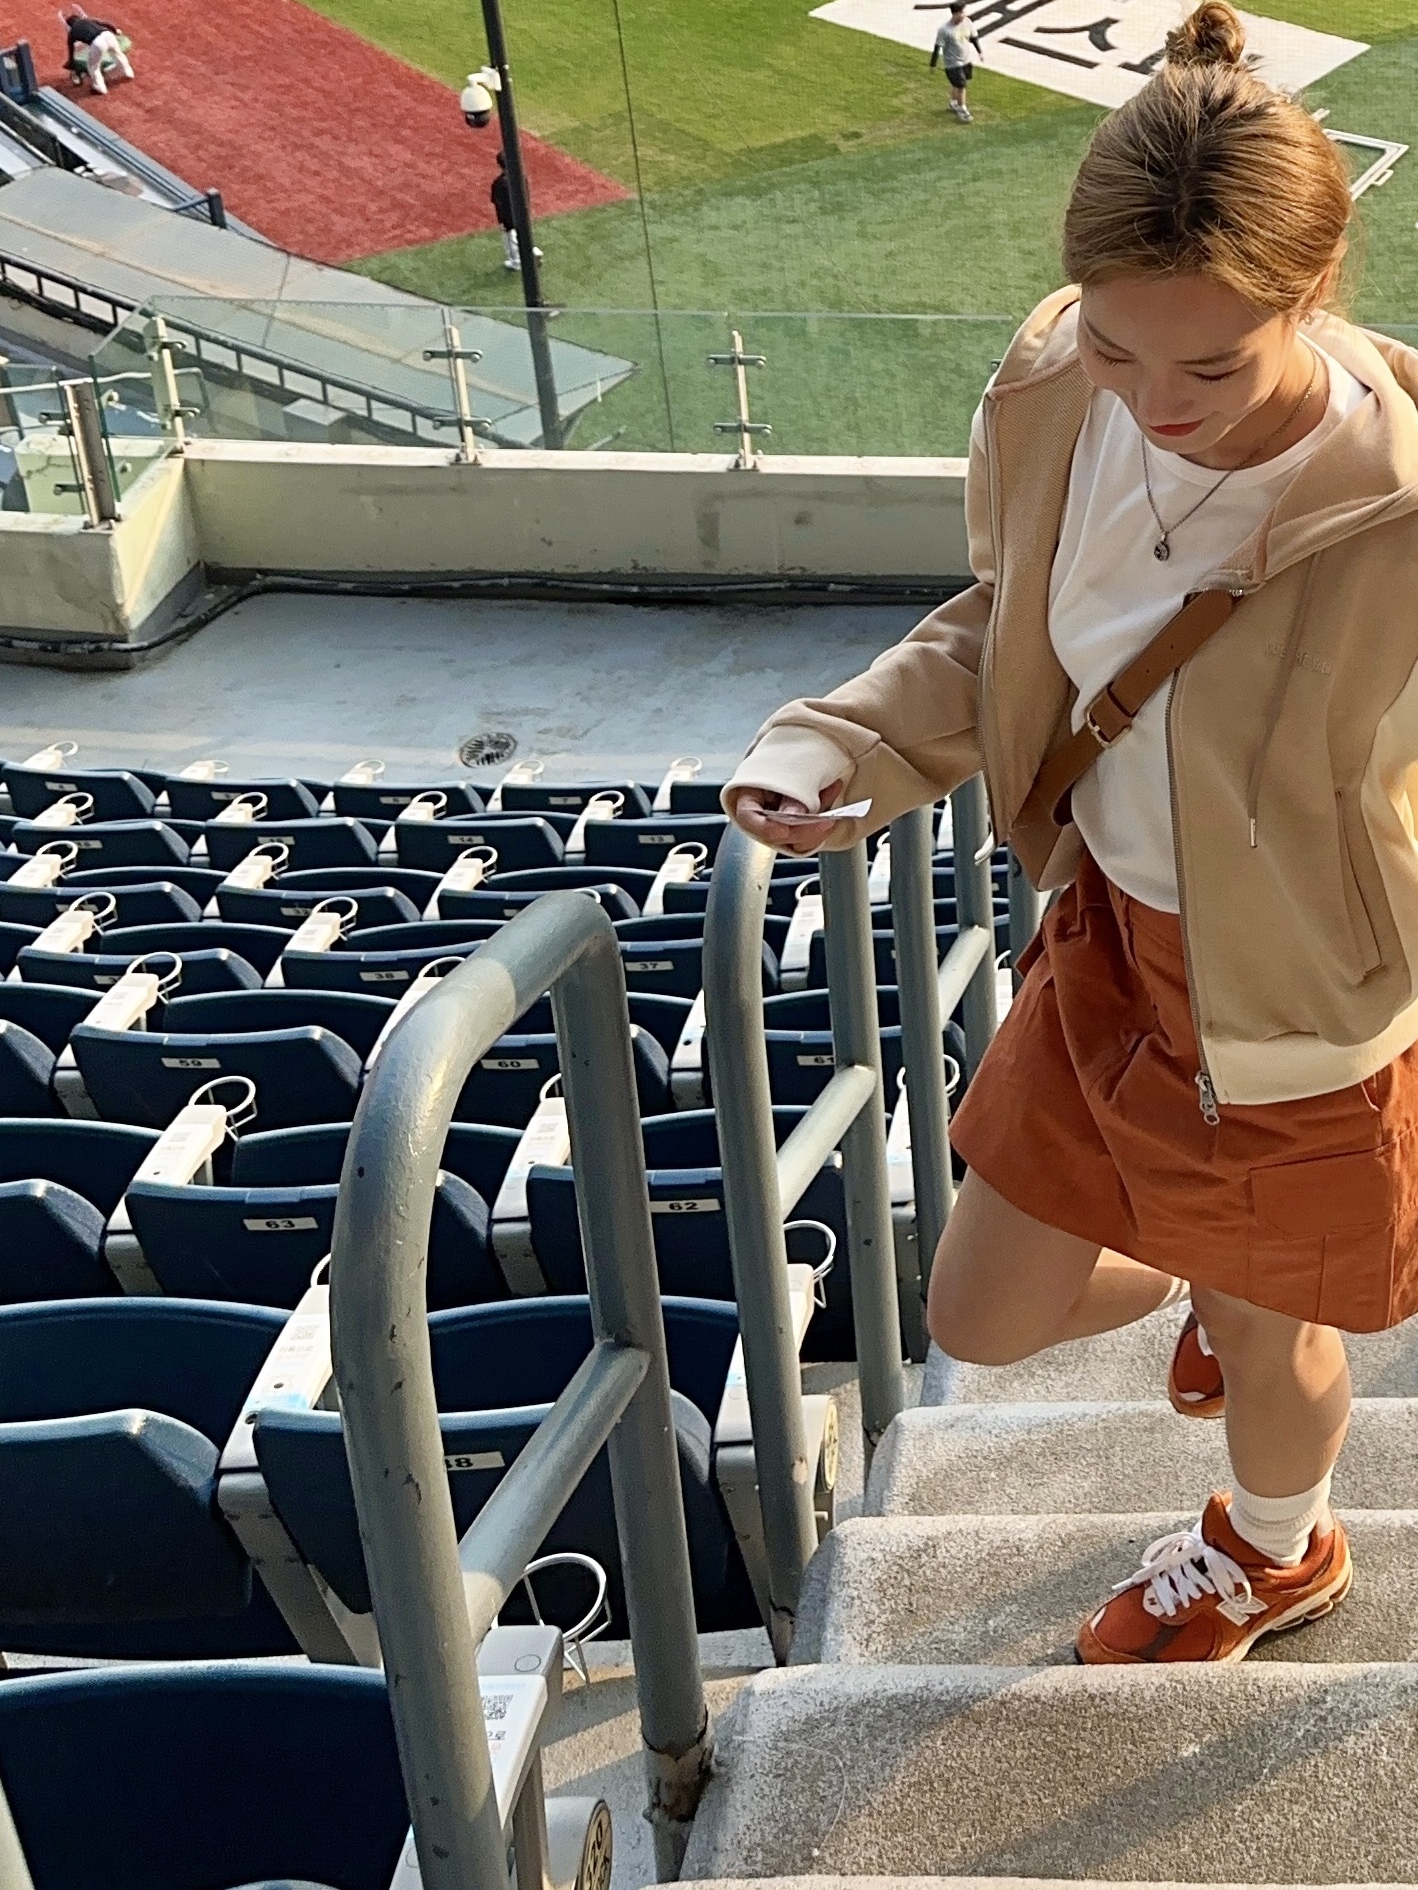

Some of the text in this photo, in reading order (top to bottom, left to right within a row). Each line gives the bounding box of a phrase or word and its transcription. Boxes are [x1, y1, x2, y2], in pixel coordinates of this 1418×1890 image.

[639, 962, 658, 970] 37
[497, 1059, 521, 1068] 60
[668, 1201, 699, 1212] 62
[265, 1219, 295, 1230] 63
